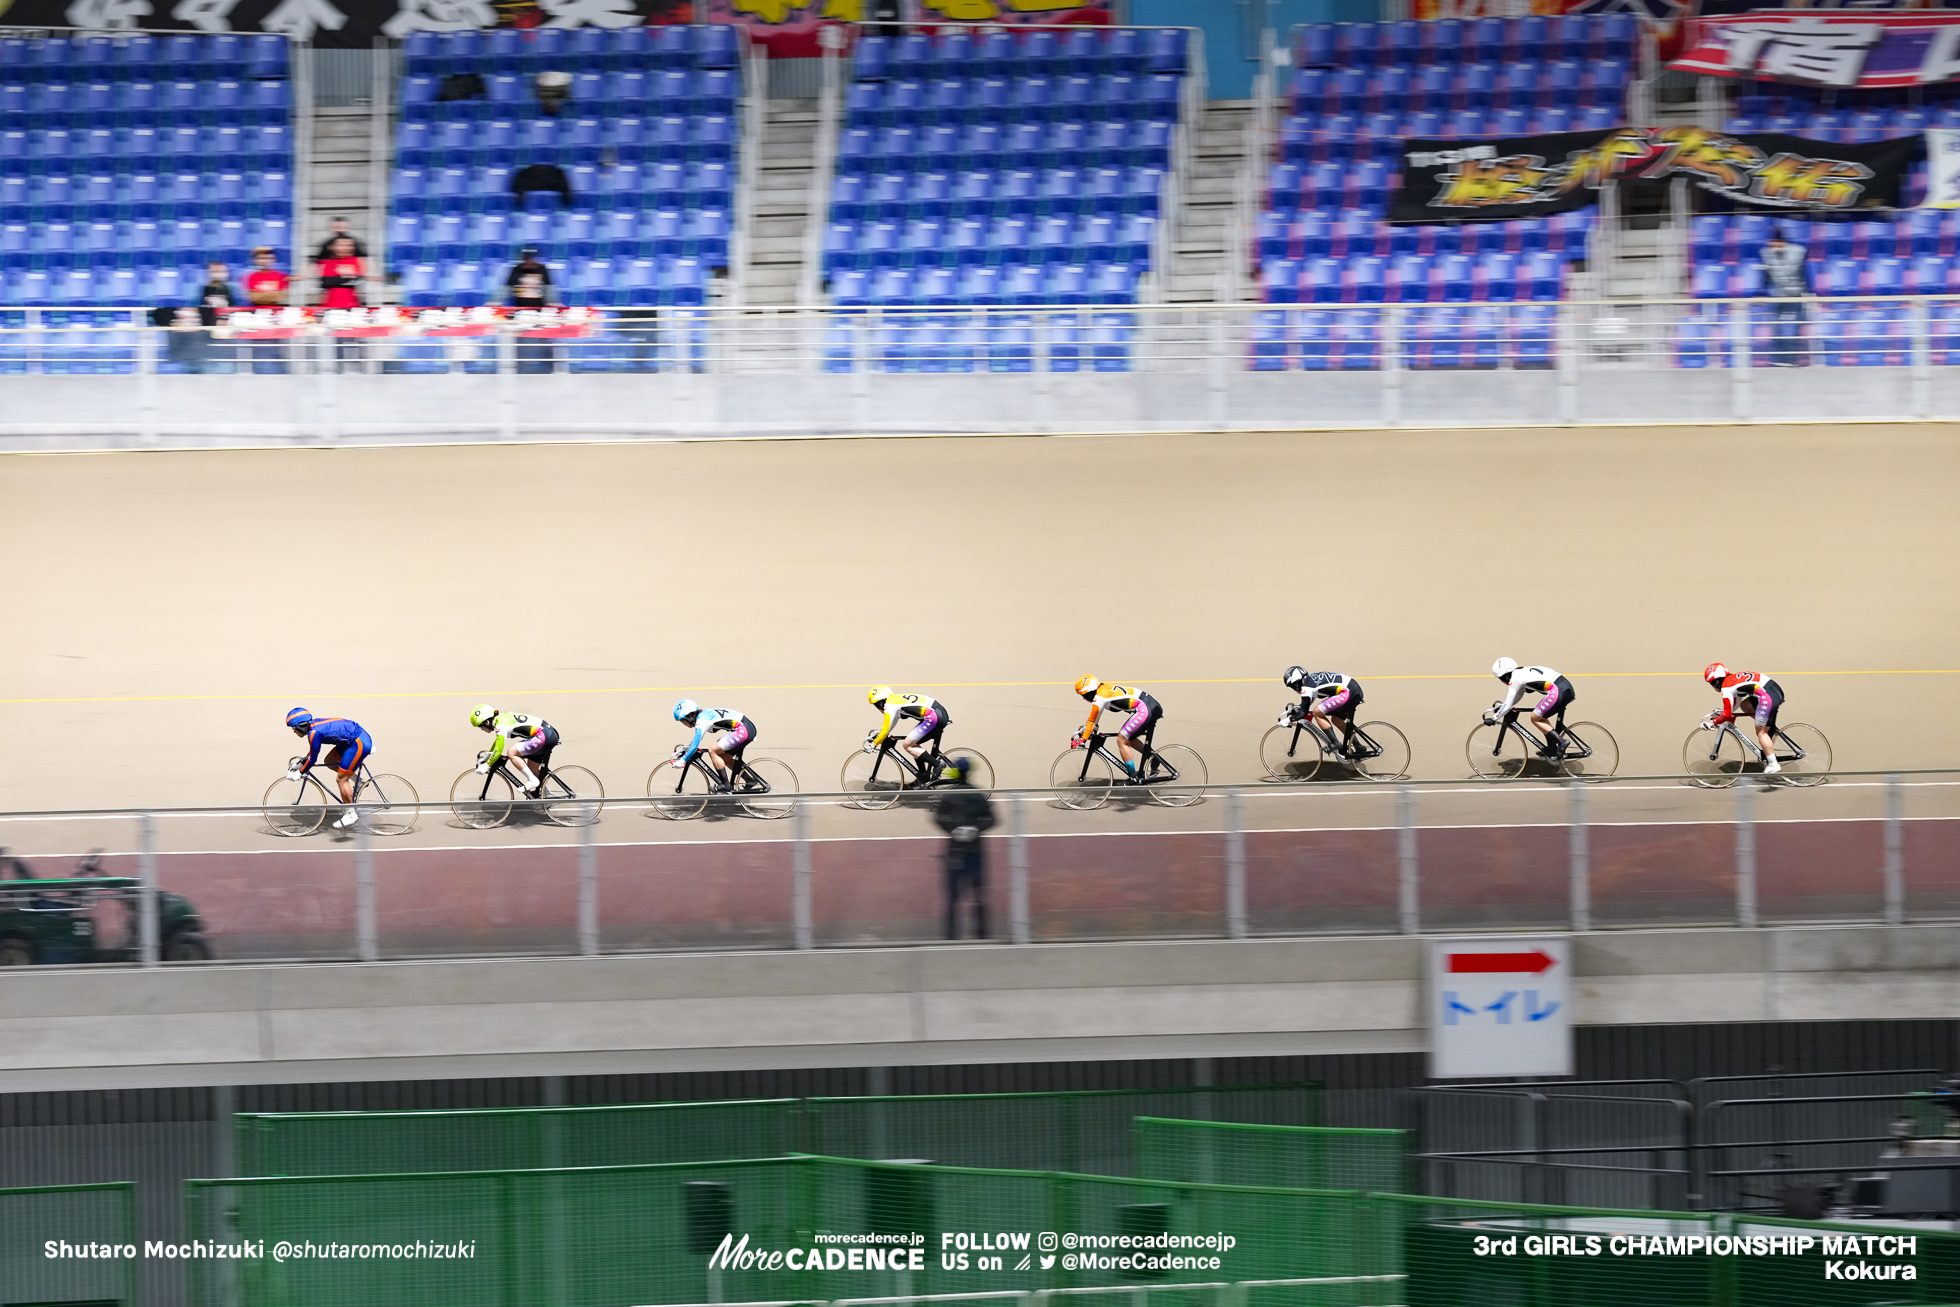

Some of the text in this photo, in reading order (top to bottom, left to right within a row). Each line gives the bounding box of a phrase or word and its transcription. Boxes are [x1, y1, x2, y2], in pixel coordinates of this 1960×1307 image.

[1737, 671, 1754, 682] 3
[1113, 685, 1128, 695] 7
[902, 694, 919, 703] 5
[714, 709, 729, 718] 4
[513, 714, 528, 724] 6
[1443, 989, 1560, 1025] トイレ
